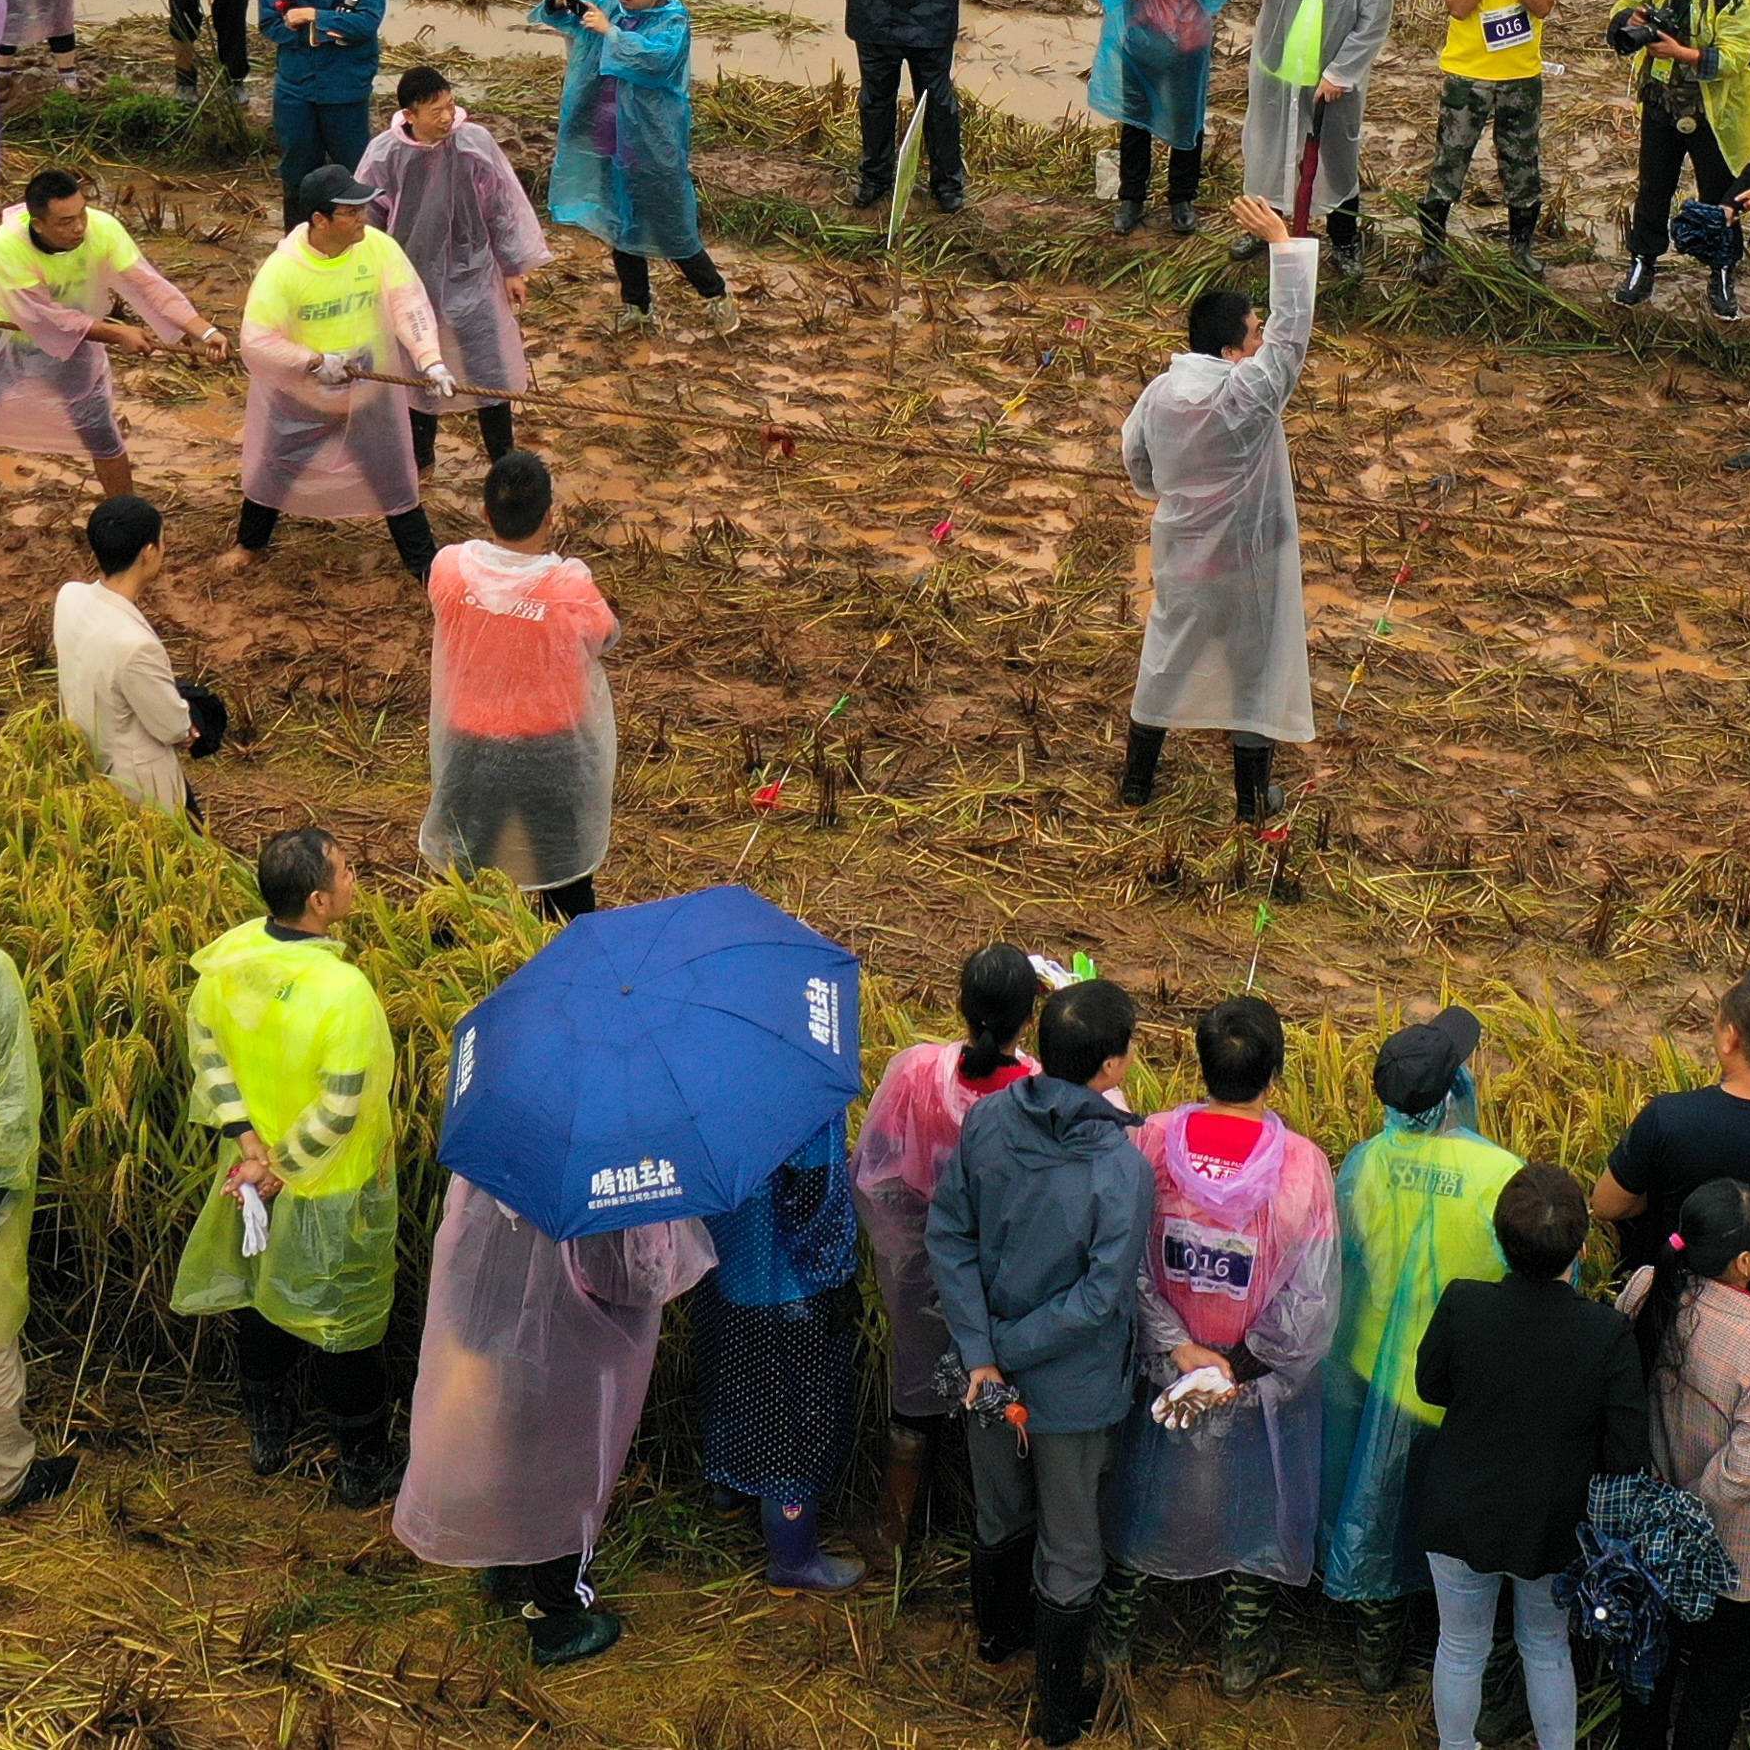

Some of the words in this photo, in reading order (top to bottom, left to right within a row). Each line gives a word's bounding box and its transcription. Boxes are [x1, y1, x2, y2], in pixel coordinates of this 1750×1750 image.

[1495, 18, 1522, 37] 016
[591, 1159, 676, 1197] 腾讯王卡
[1183, 1248, 1231, 1277] 016
